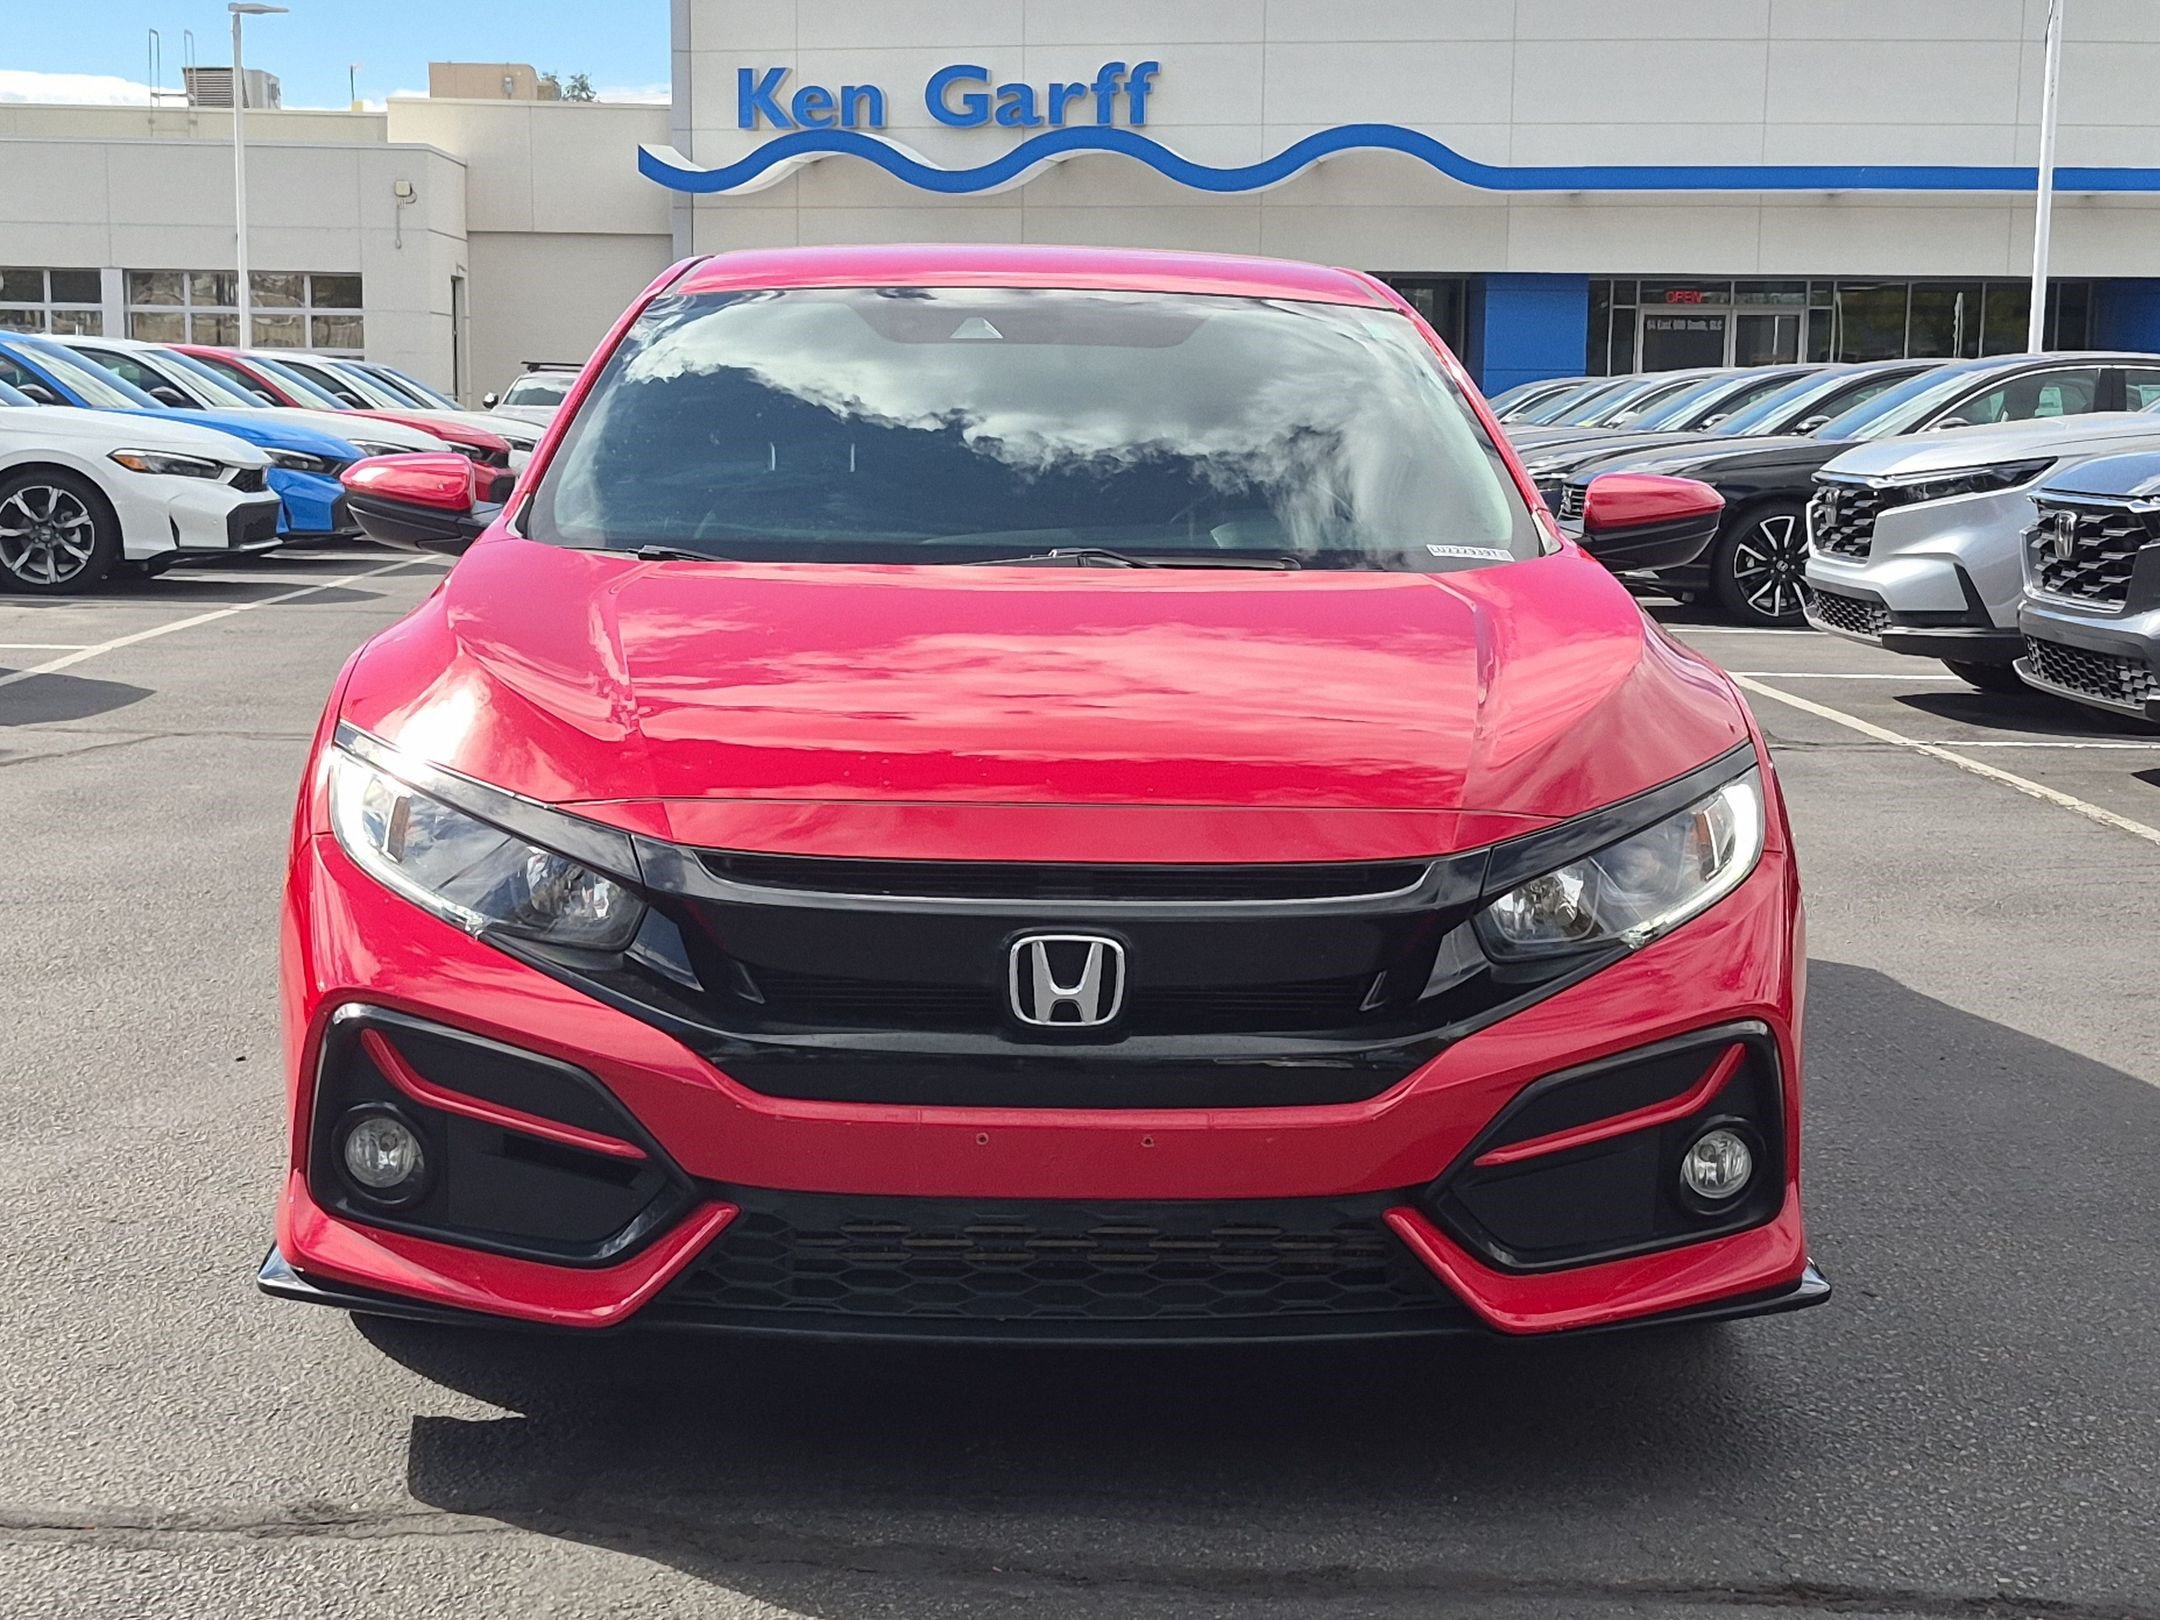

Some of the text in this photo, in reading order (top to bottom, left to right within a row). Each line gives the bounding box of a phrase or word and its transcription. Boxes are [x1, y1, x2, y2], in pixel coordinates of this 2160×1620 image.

[737, 60, 1160, 130] Ken Garff
[1665, 290, 1703, 304] OPEN
